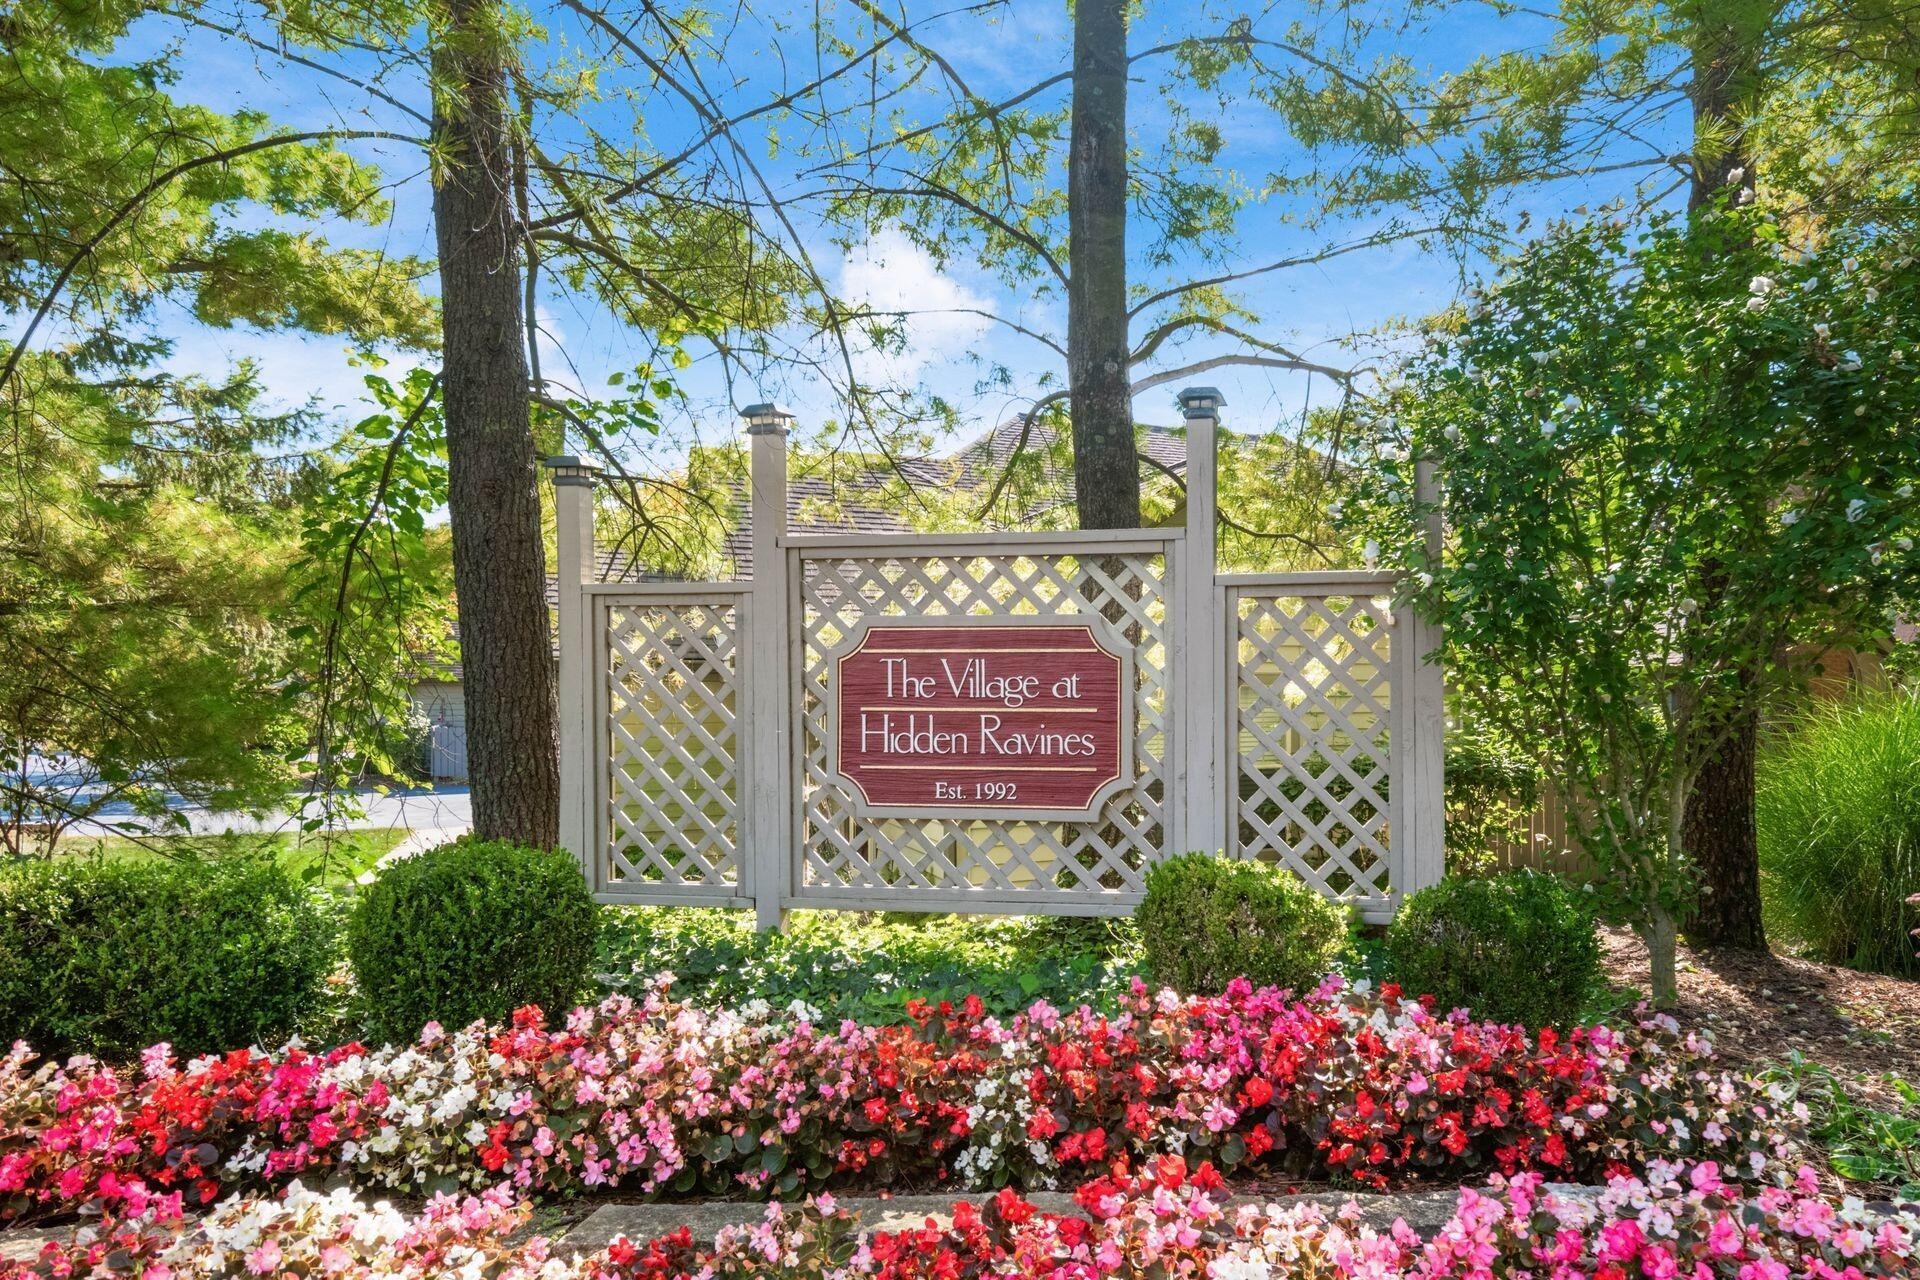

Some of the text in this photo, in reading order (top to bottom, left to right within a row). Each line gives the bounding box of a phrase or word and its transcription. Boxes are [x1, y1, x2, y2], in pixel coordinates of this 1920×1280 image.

[879, 657, 1081, 708] The Village at
[860, 714, 1096, 756] Hidden Ravines
[935, 782, 1017, 800] Est. 1992
